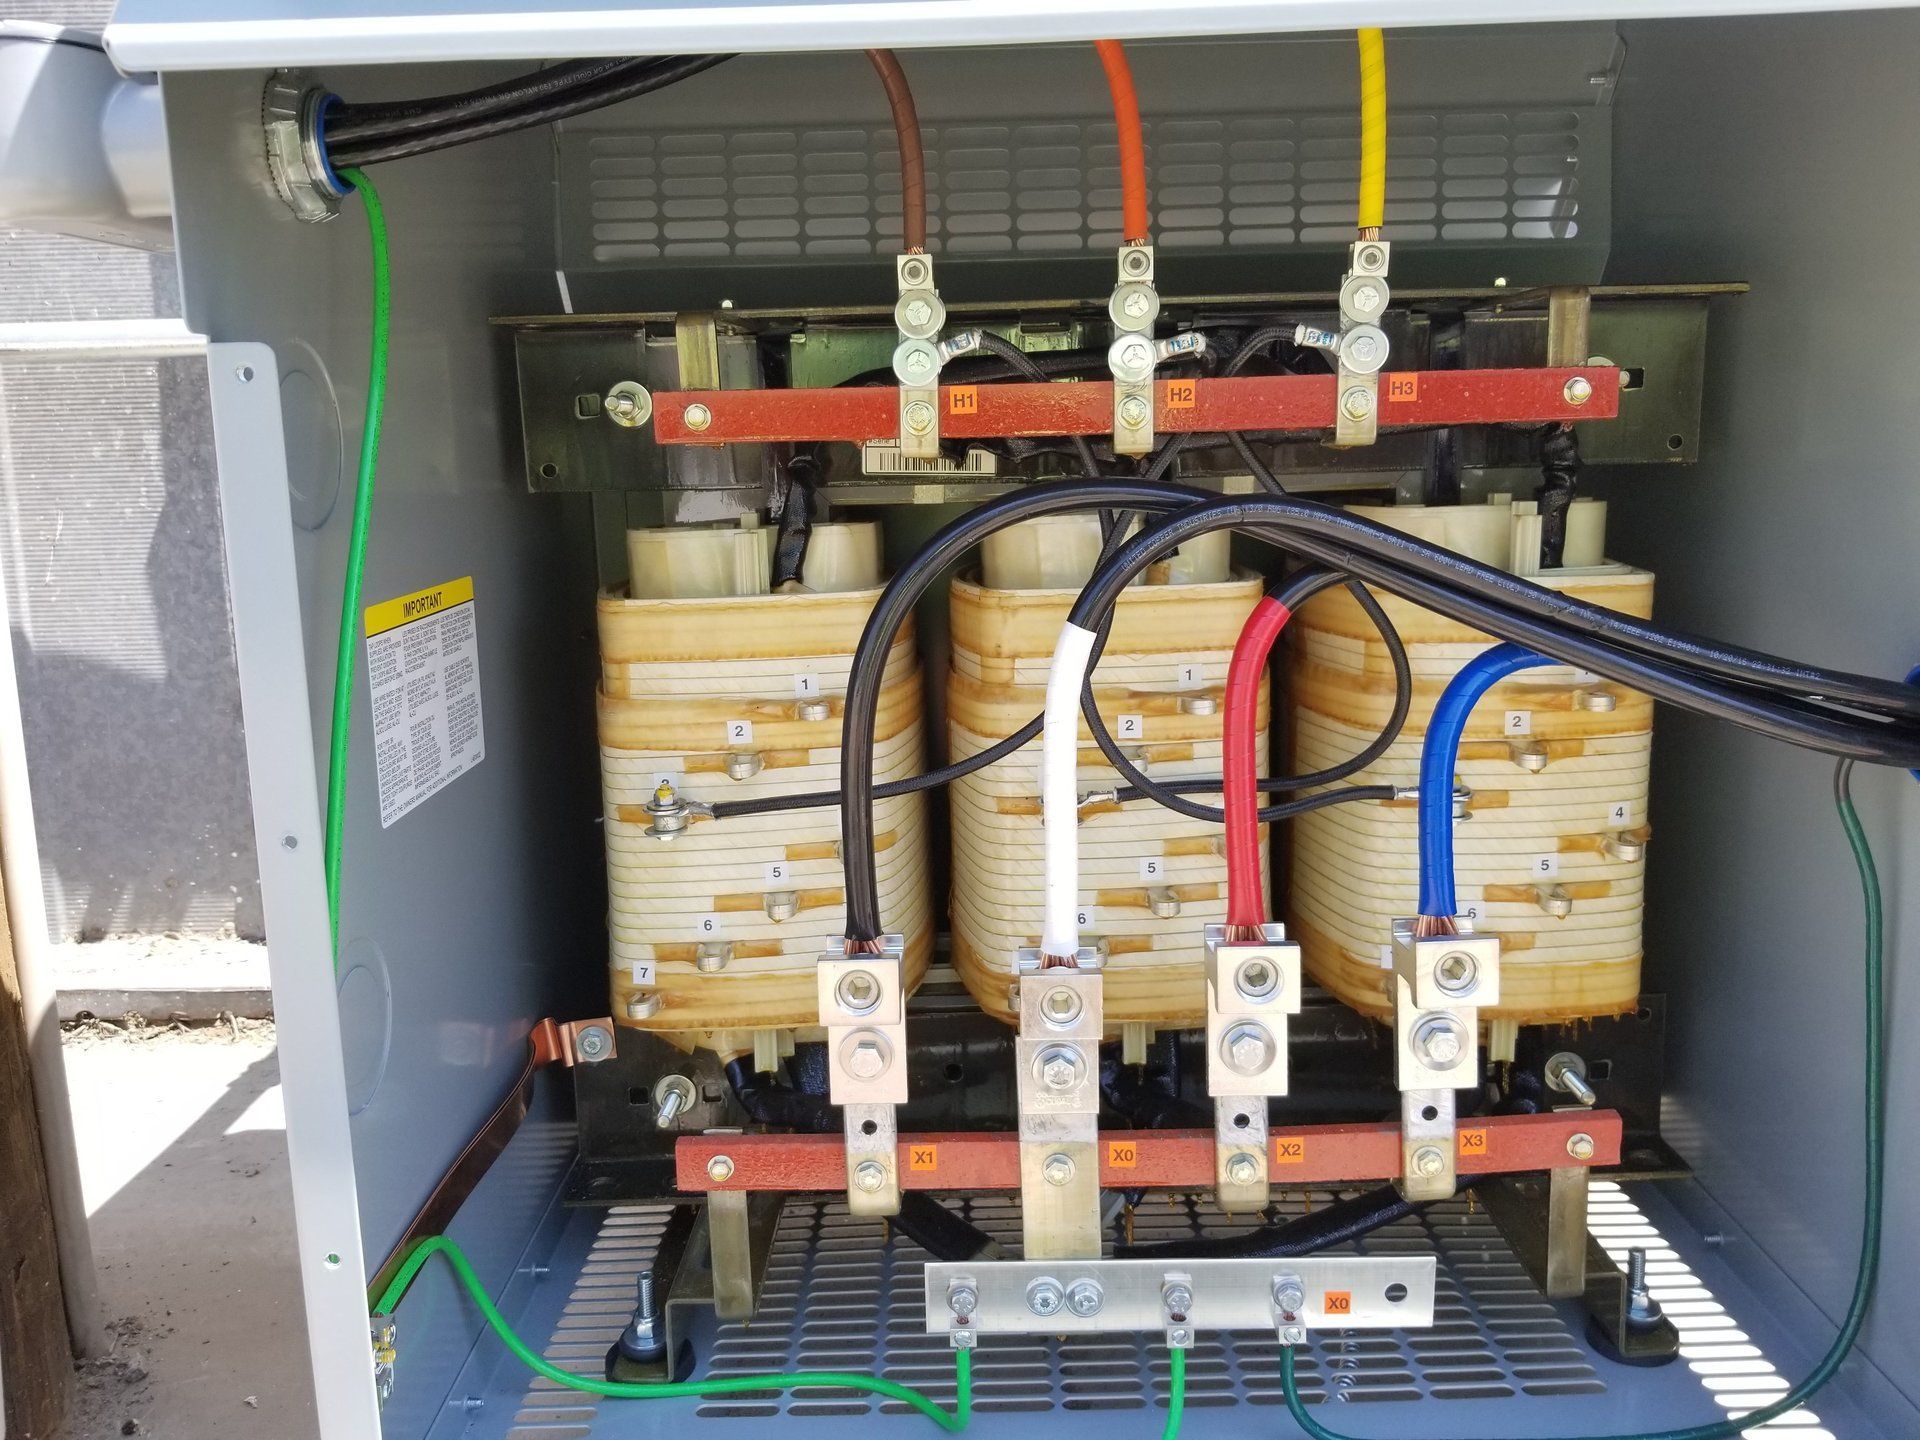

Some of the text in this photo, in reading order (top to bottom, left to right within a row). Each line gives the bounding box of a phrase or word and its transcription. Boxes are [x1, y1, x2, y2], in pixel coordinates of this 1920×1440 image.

[1170, 387, 1193, 402] H2
[1392, 381, 1414, 396] H3
[953, 393, 975, 409] H1
[1454, 560, 1475, 575] LEAD
[1475, 568, 1496, 584] FREE
[402, 591, 443, 619] IMPORTANT
[1185, 669, 1192, 681] 1
[801, 678, 808, 690] 1
[1125, 719, 1135, 731] 2
[1512, 716, 1522, 728] 2
[734, 725, 744, 737] 2
[1615, 807, 1624, 818] 4
[1147, 862, 1156, 874] 5
[1540, 859, 1550, 871] 5
[772, 866, 782, 878] 5
[1077, 913, 1087, 925] 6
[1468, 907, 1477, 919] 6
[703, 919, 713, 931] 6
[640, 967, 649, 979] 7
[1462, 1134, 1484, 1148] X3
[1113, 1148, 1134, 1162] X0
[1279, 1143, 1302, 1157] X2
[914, 1150, 934, 1164] X1
[1328, 1297, 1350, 1311] X0
